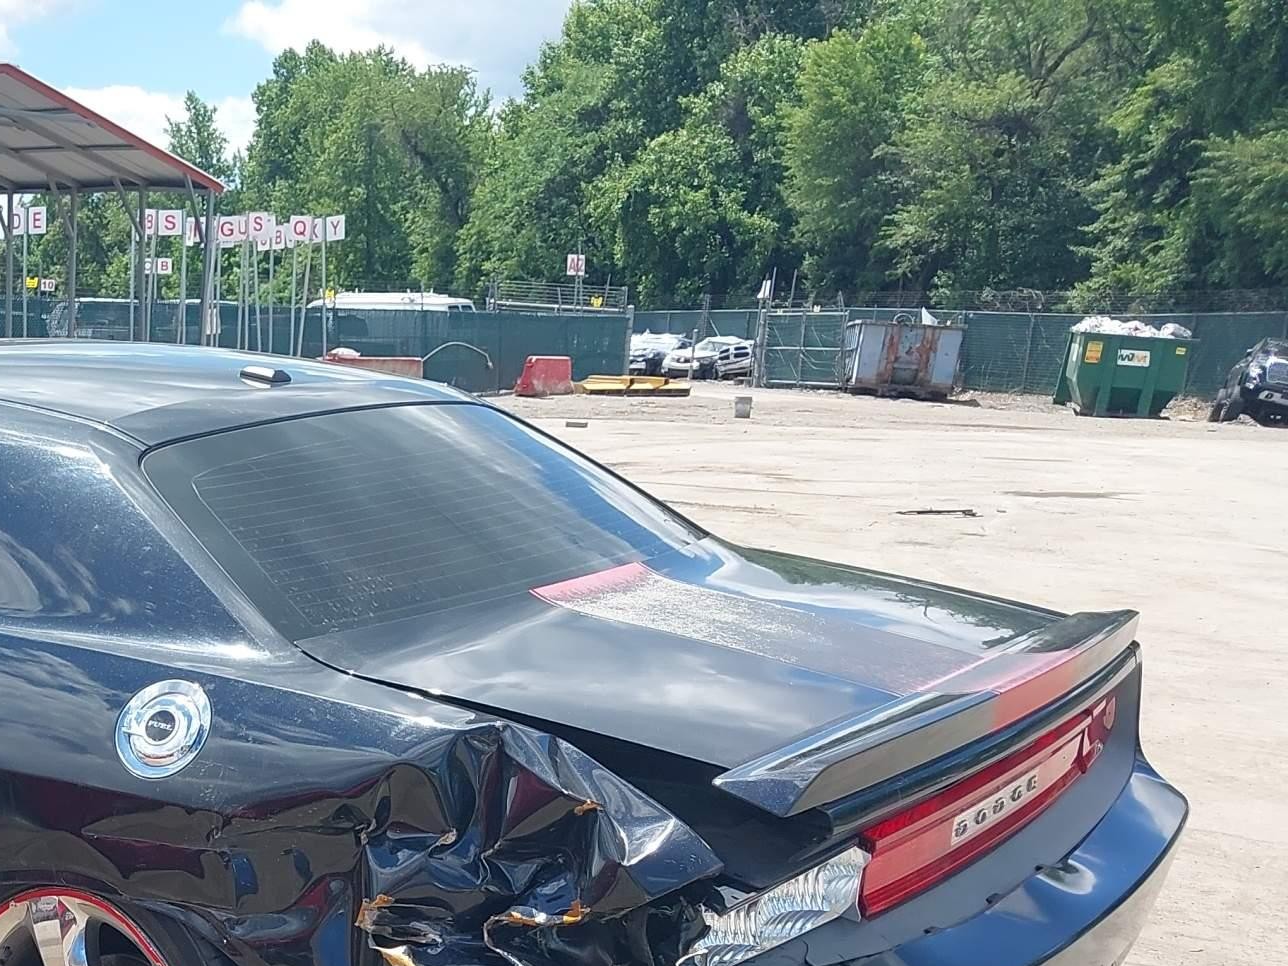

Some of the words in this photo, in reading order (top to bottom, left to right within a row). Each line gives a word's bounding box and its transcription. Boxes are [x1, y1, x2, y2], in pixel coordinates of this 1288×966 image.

[33, 212, 41, 228] E
[164, 215, 176, 230] S
[253, 216, 263, 231] S
[221, 221, 234, 237] G
[294, 220, 306, 237] Q
[330, 220, 340, 236] Y
[161, 261, 168, 271] B
[43, 281, 54, 290] 10
